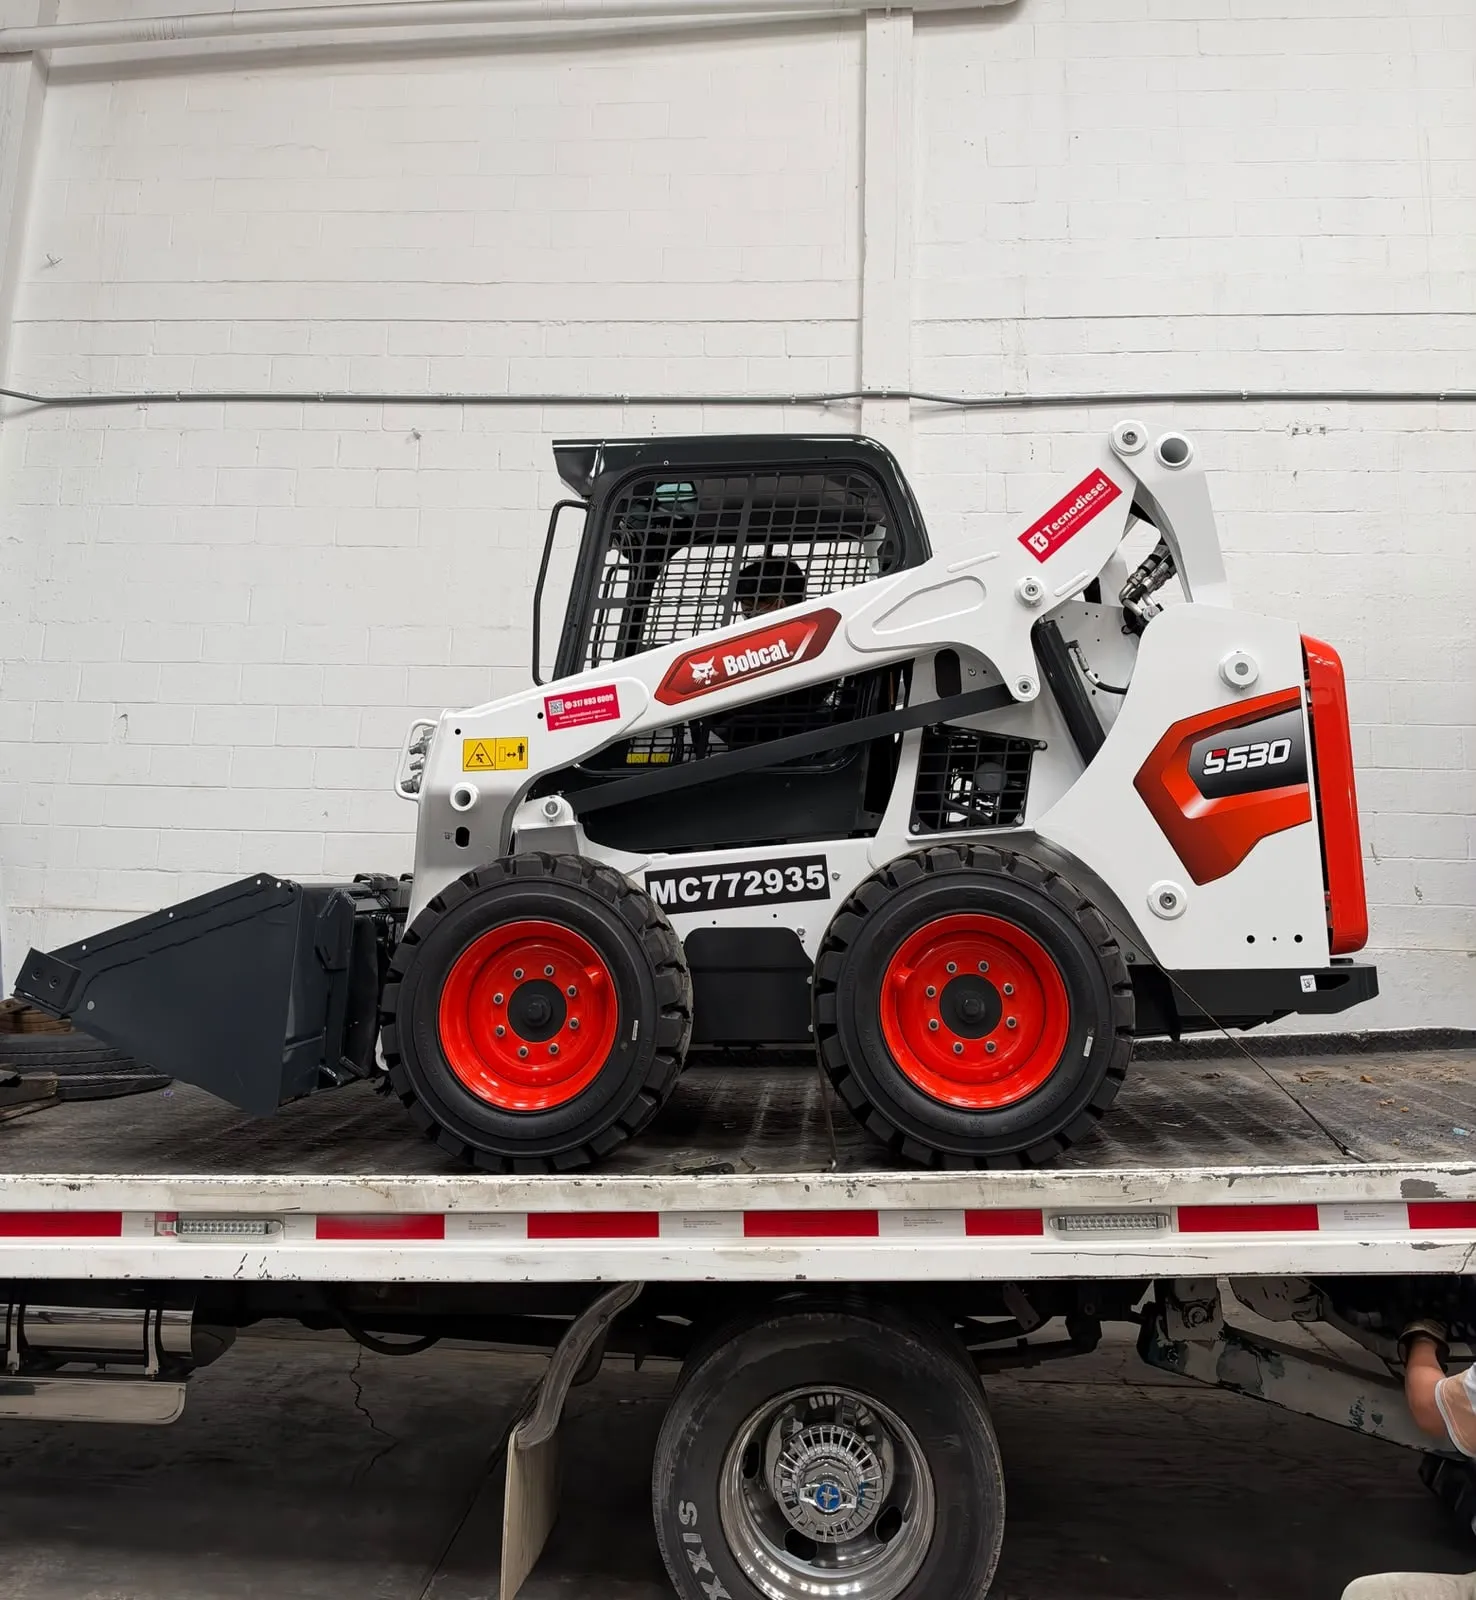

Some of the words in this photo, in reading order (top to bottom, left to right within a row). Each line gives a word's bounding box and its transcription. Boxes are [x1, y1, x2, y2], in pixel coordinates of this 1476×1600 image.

[1042, 478, 1108, 536] Tecnodiesel
[722, 639, 790, 677] Bobcat
[1203, 739, 1292, 775] S530
[650, 864, 826, 905] MC772935
